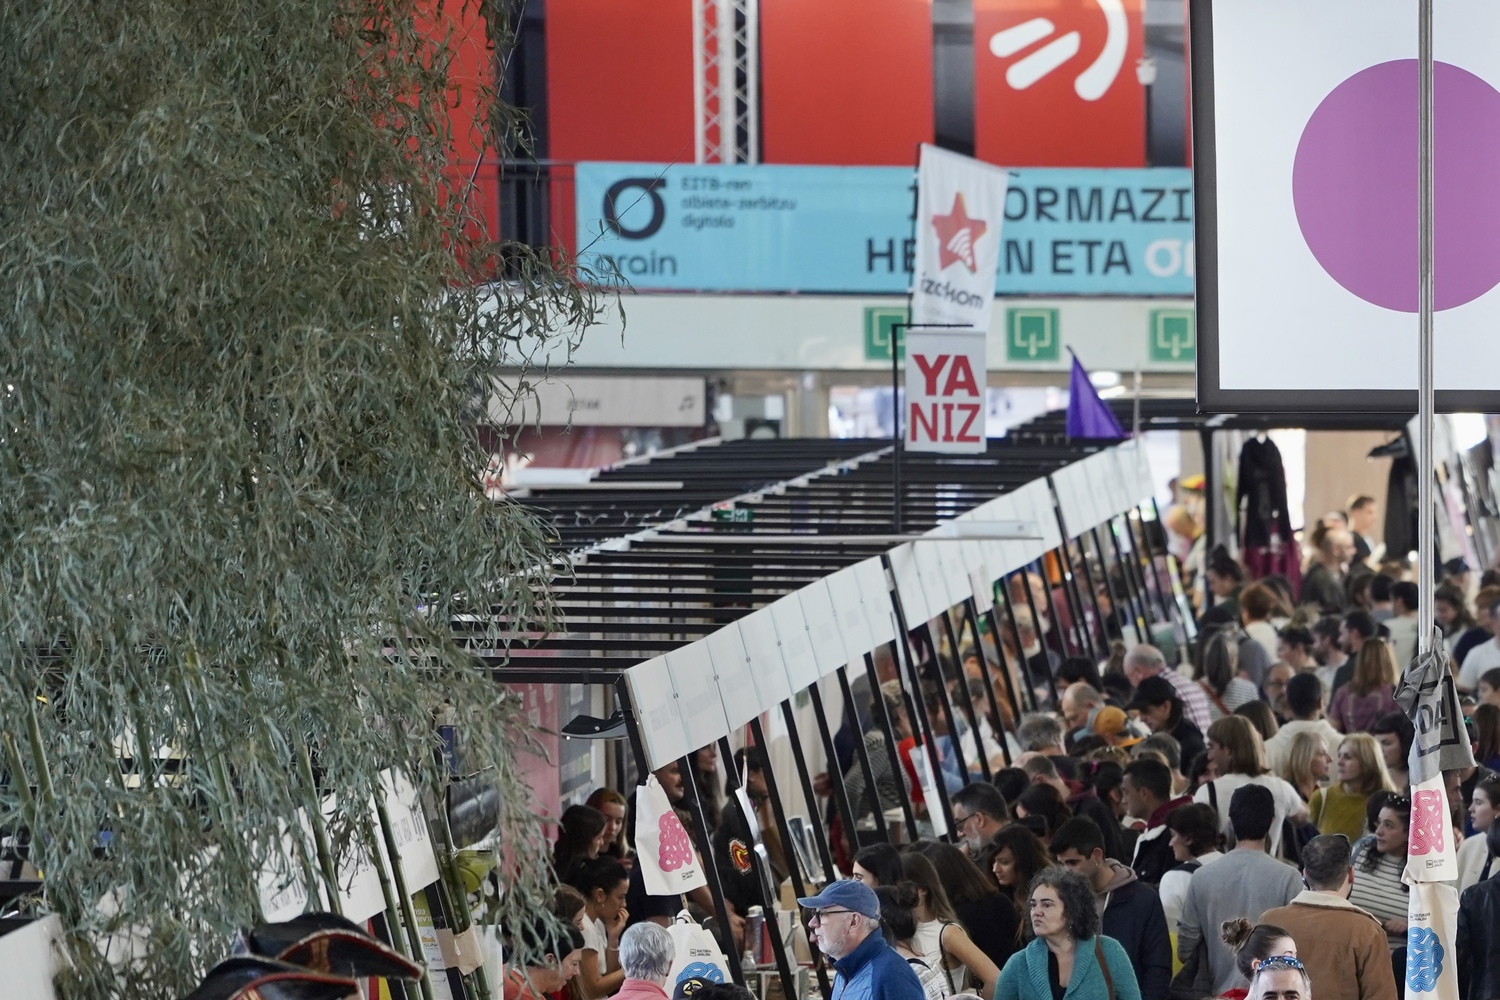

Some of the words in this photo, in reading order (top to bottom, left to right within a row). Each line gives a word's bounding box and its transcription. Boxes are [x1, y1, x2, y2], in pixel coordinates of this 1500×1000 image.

[908, 186, 1190, 223] IORMAZI
[1051, 238, 1132, 275] ETA
[912, 354, 979, 398] YA
[910, 403, 981, 443] NIZ
